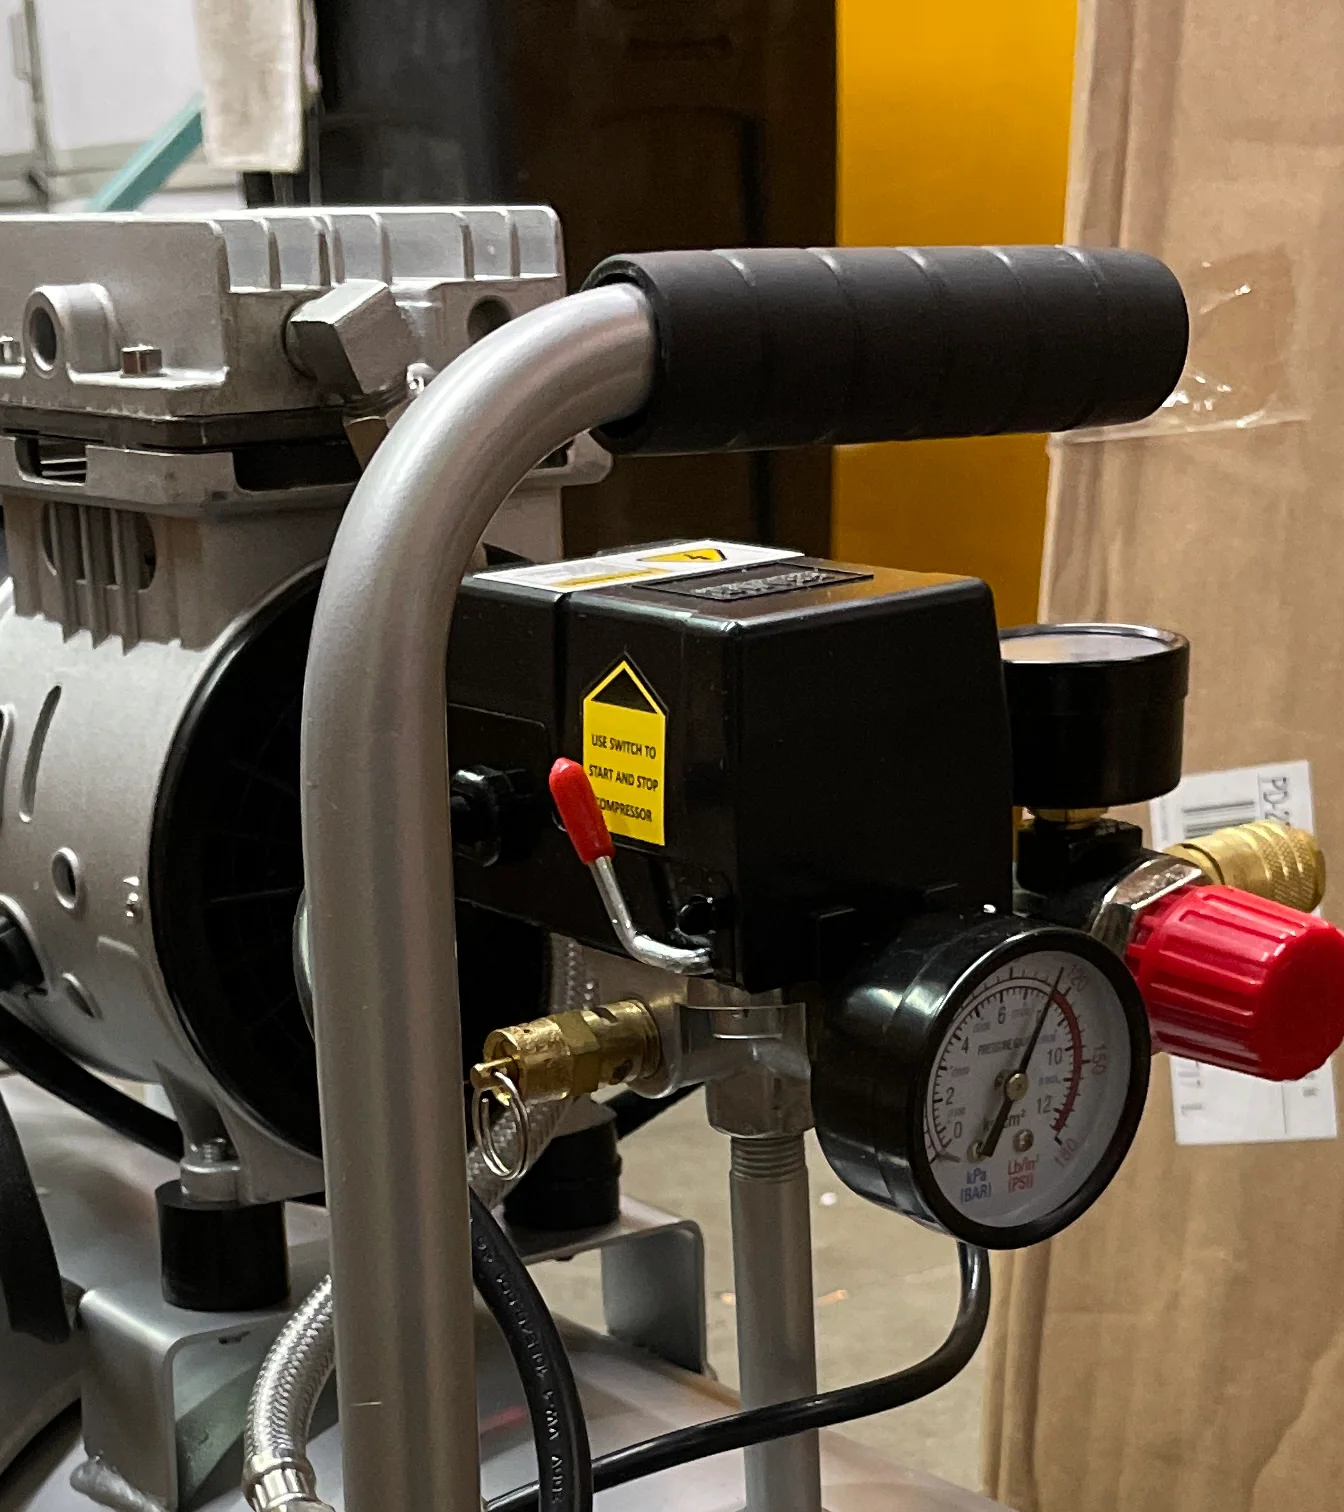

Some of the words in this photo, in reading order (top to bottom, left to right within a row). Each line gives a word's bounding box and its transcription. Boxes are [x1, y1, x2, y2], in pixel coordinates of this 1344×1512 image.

[591, 733, 608, 750] USE
[609, 738, 643, 757] SWITCH
[644, 745, 657, 760] TO
[588, 763, 614, 782] START
[615, 770, 635, 787] AND
[636, 775, 659, 792] STOP
[997, 1005, 1007, 1025] 6
[960, 1035, 969, 1054] 4
[1046, 1047, 1064, 1066] 10
[944, 1086, 955, 1106] 2
[1036, 1094, 1053, 1114] 12
[953, 1121, 963, 1139] 0
[960, 1182, 992, 1204] (BAR)
